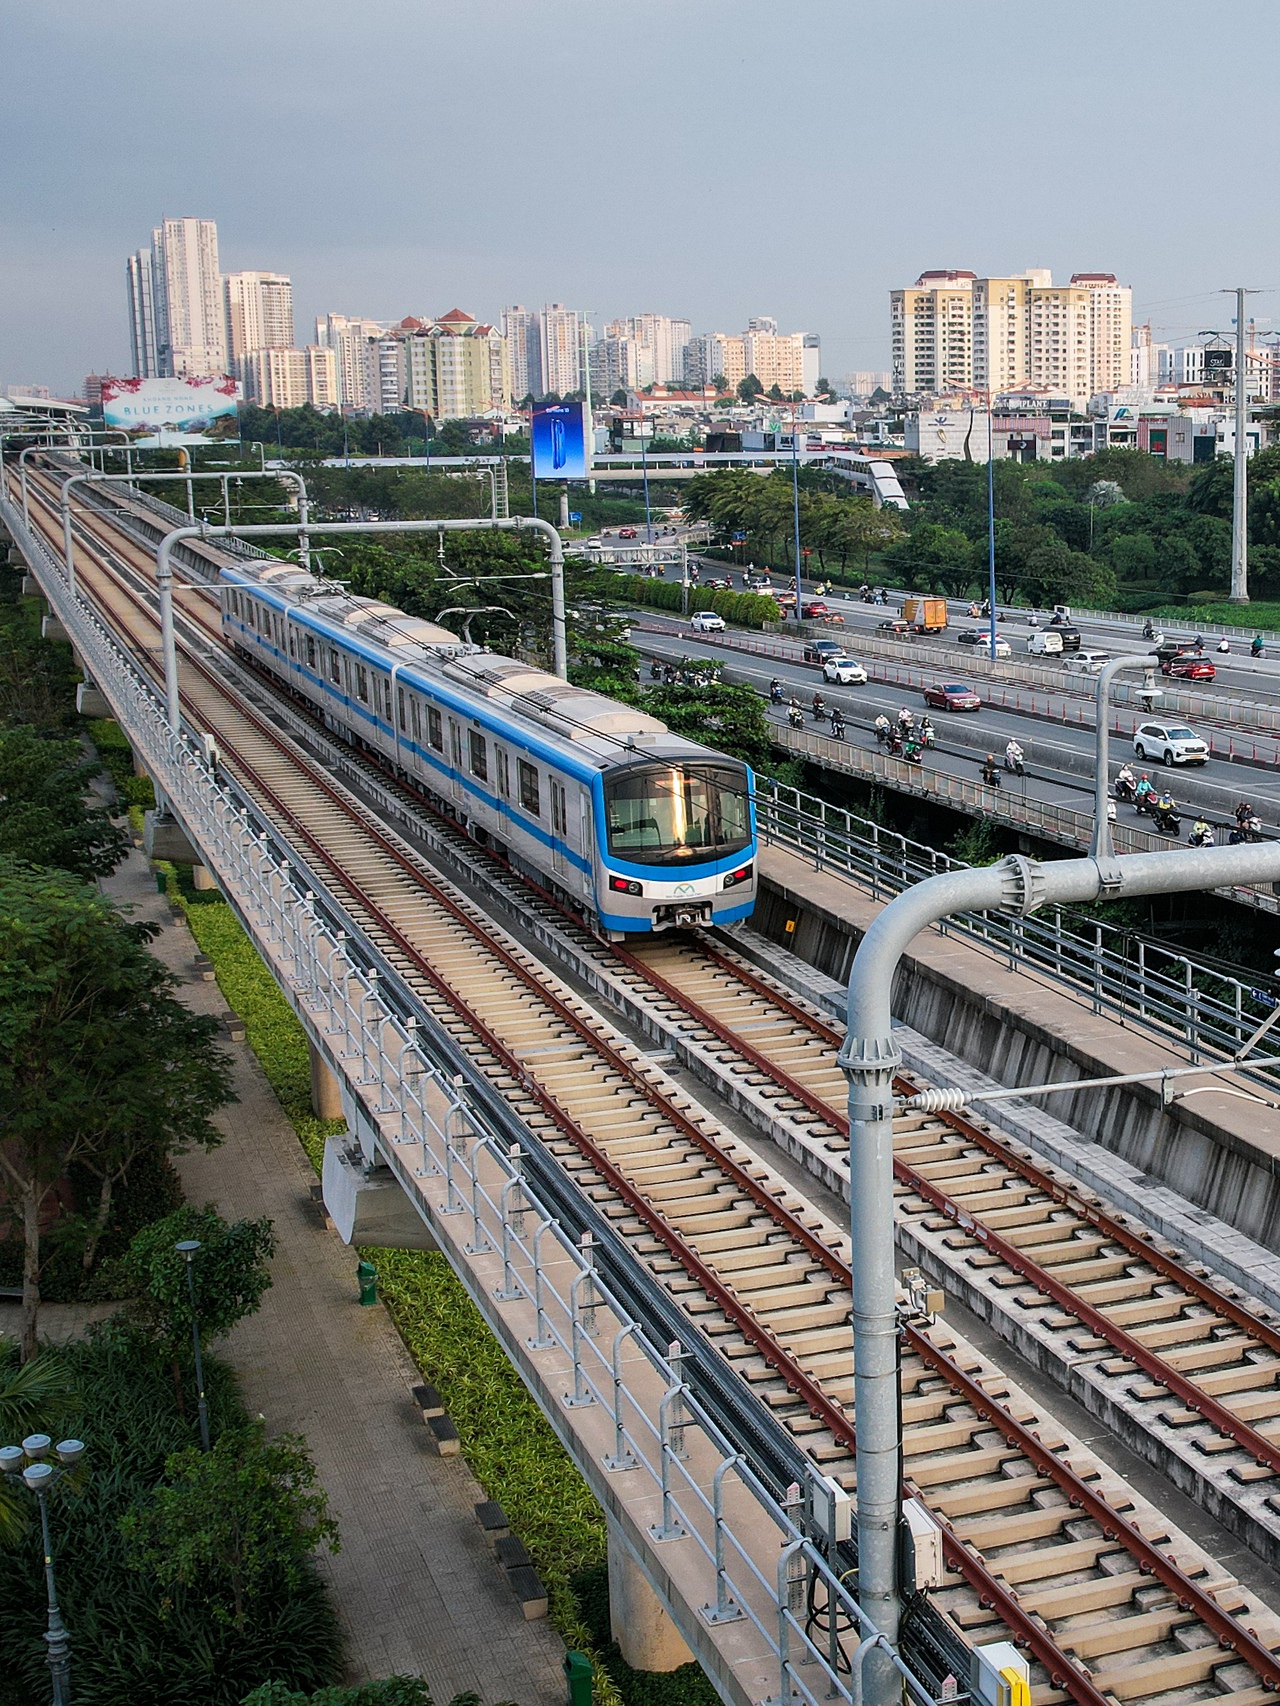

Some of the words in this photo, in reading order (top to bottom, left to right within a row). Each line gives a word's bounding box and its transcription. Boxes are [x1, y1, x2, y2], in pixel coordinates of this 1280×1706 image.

[1223, 395, 1255, 405] HOEL
[124, 406, 159, 415] BLUE
[166, 404, 214, 414] ZONES
